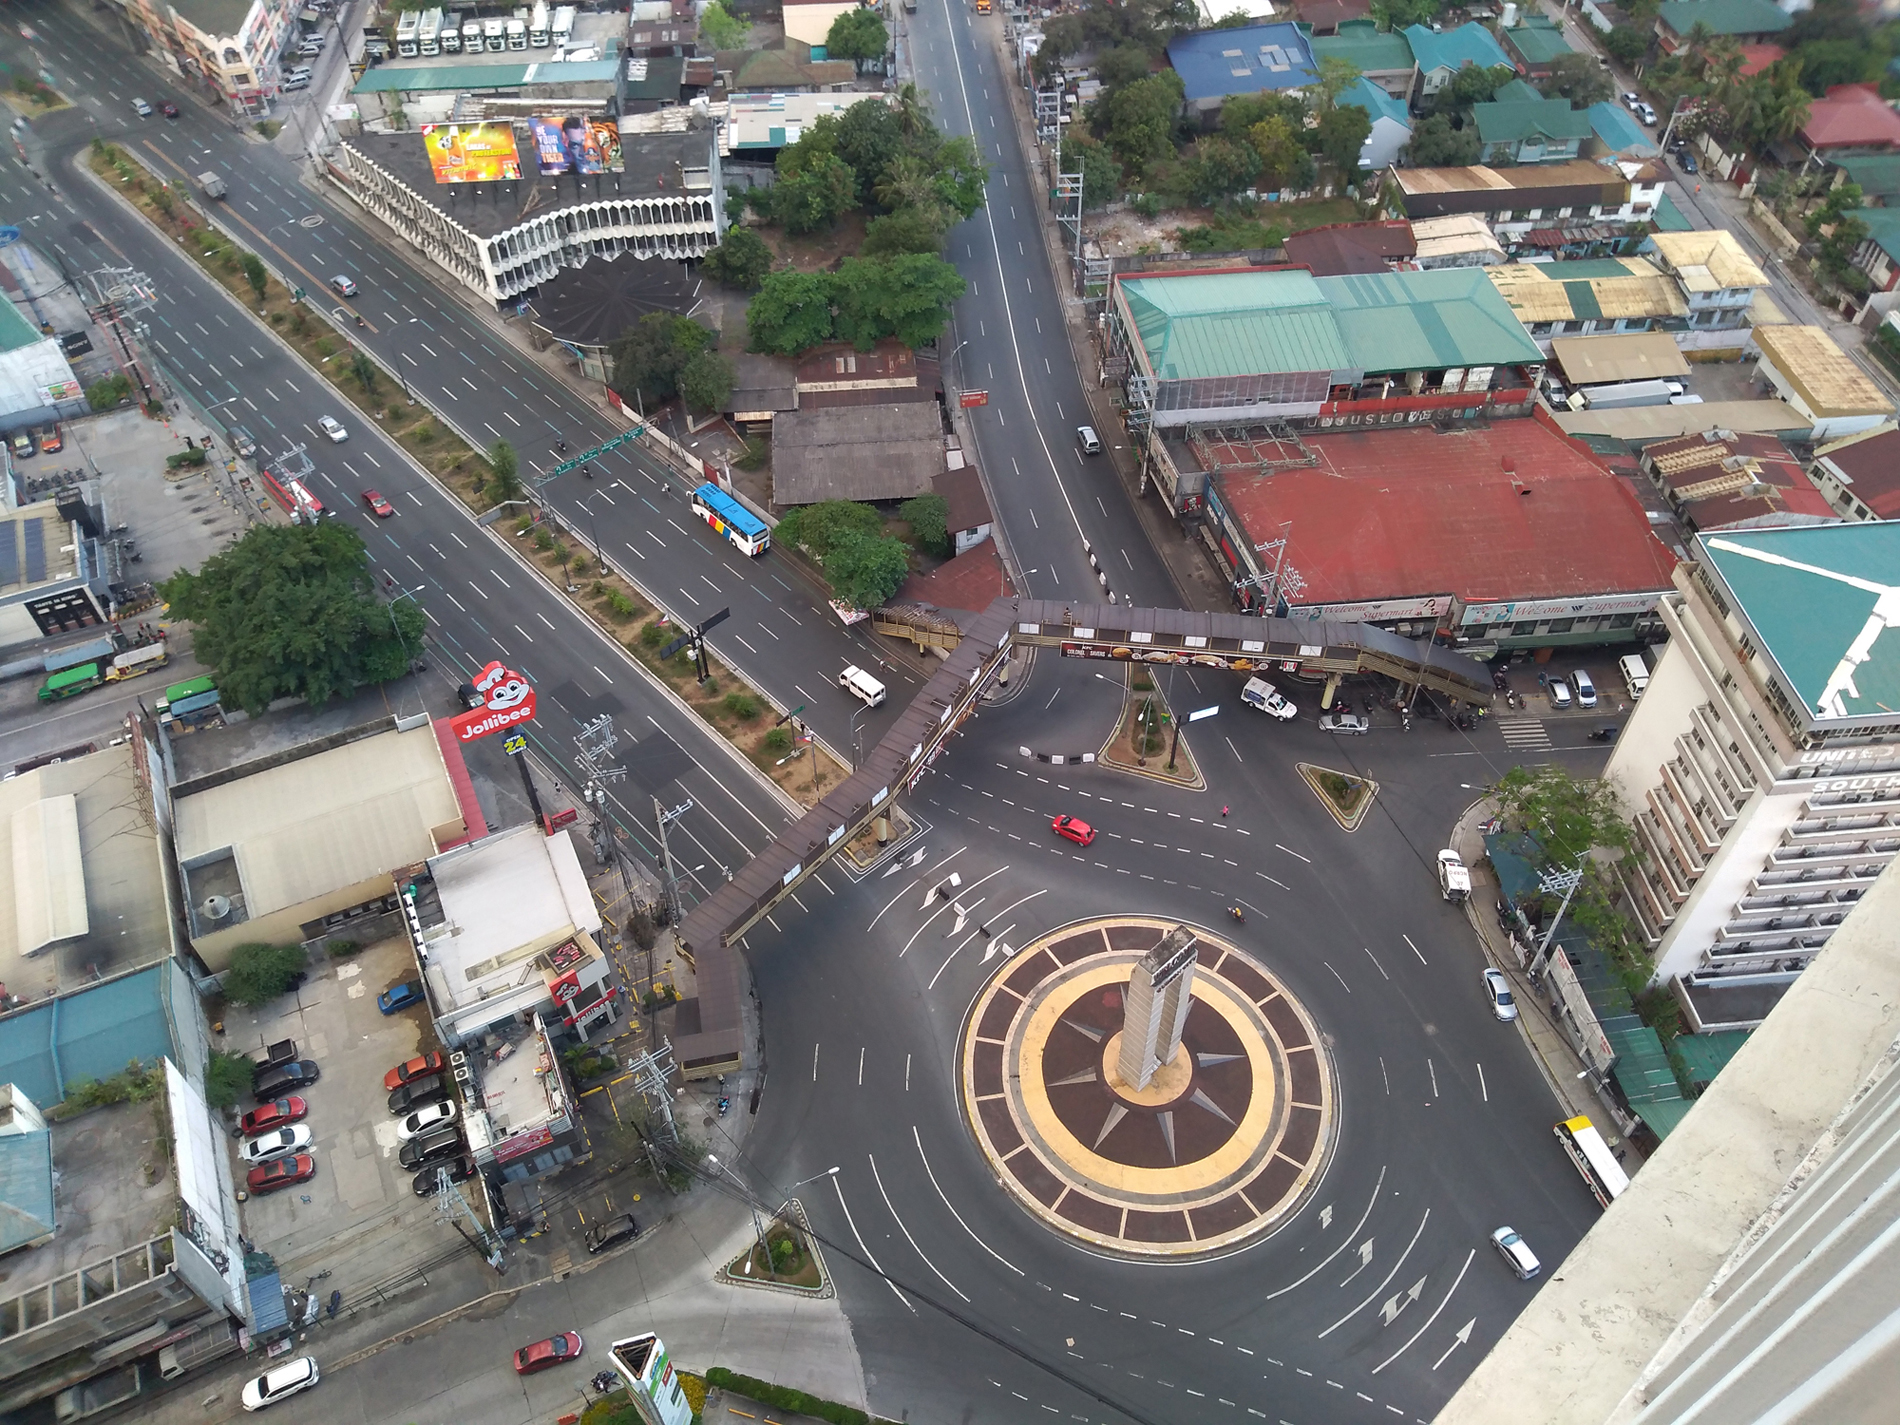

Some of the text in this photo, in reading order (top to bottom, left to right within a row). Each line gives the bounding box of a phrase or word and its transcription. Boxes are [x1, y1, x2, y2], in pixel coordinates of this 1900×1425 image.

[537, 134, 559, 145] YOUR
[540, 152, 564, 163] TIGER
[67, 339, 88, 350] SONY
[1324, 605, 1369, 614] Welcome
[1360, 607, 1413, 620] Supermart
[461, 706, 531, 739] Jollibee
[506, 734, 521, 743] OPEN
[504, 736, 527, 753] 24
[910, 766, 927, 790] KFC
